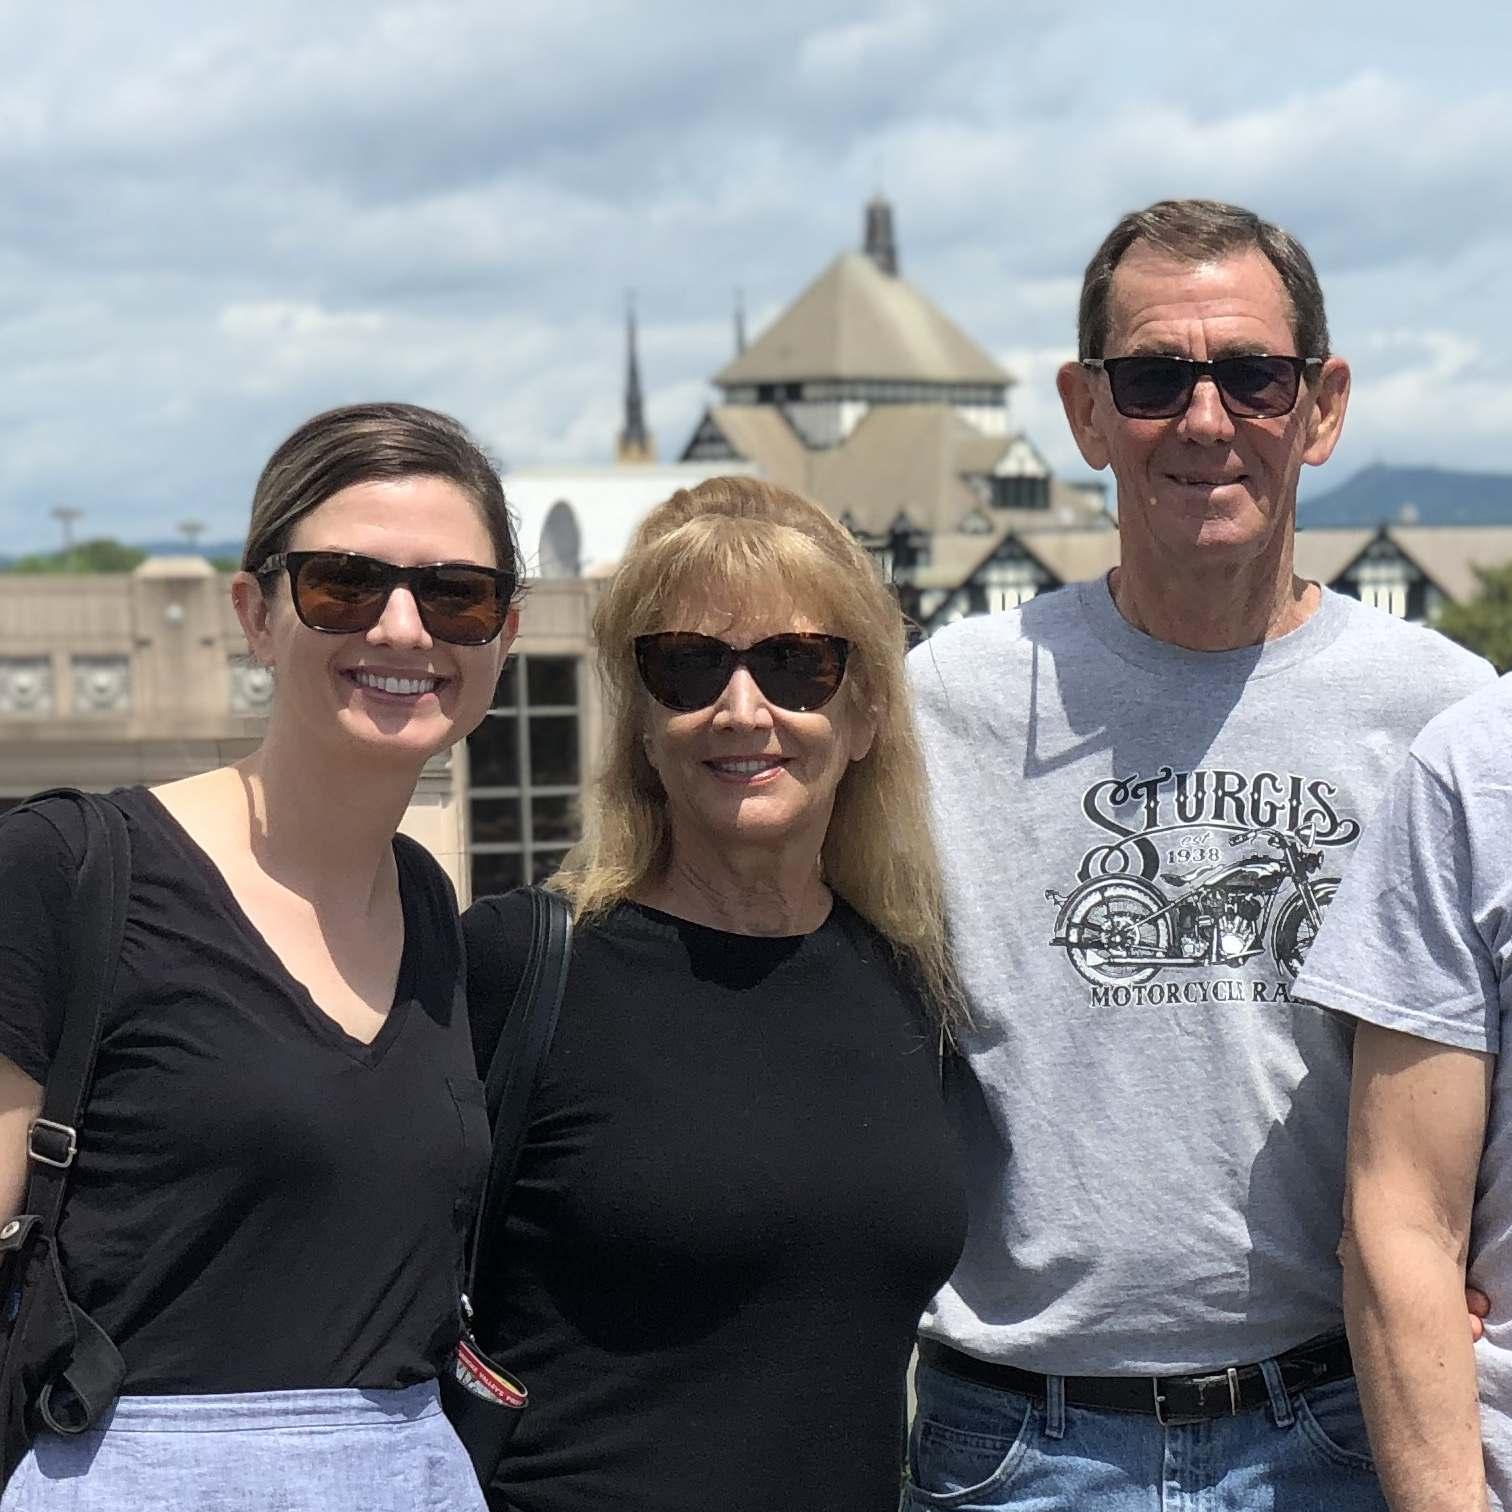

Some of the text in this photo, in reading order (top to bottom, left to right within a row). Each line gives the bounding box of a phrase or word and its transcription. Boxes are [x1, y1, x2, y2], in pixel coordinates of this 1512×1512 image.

[1079, 767, 1360, 882] STURGIS
[1167, 848, 1221, 865] 1938
[1252, 980, 1298, 1003] RA
